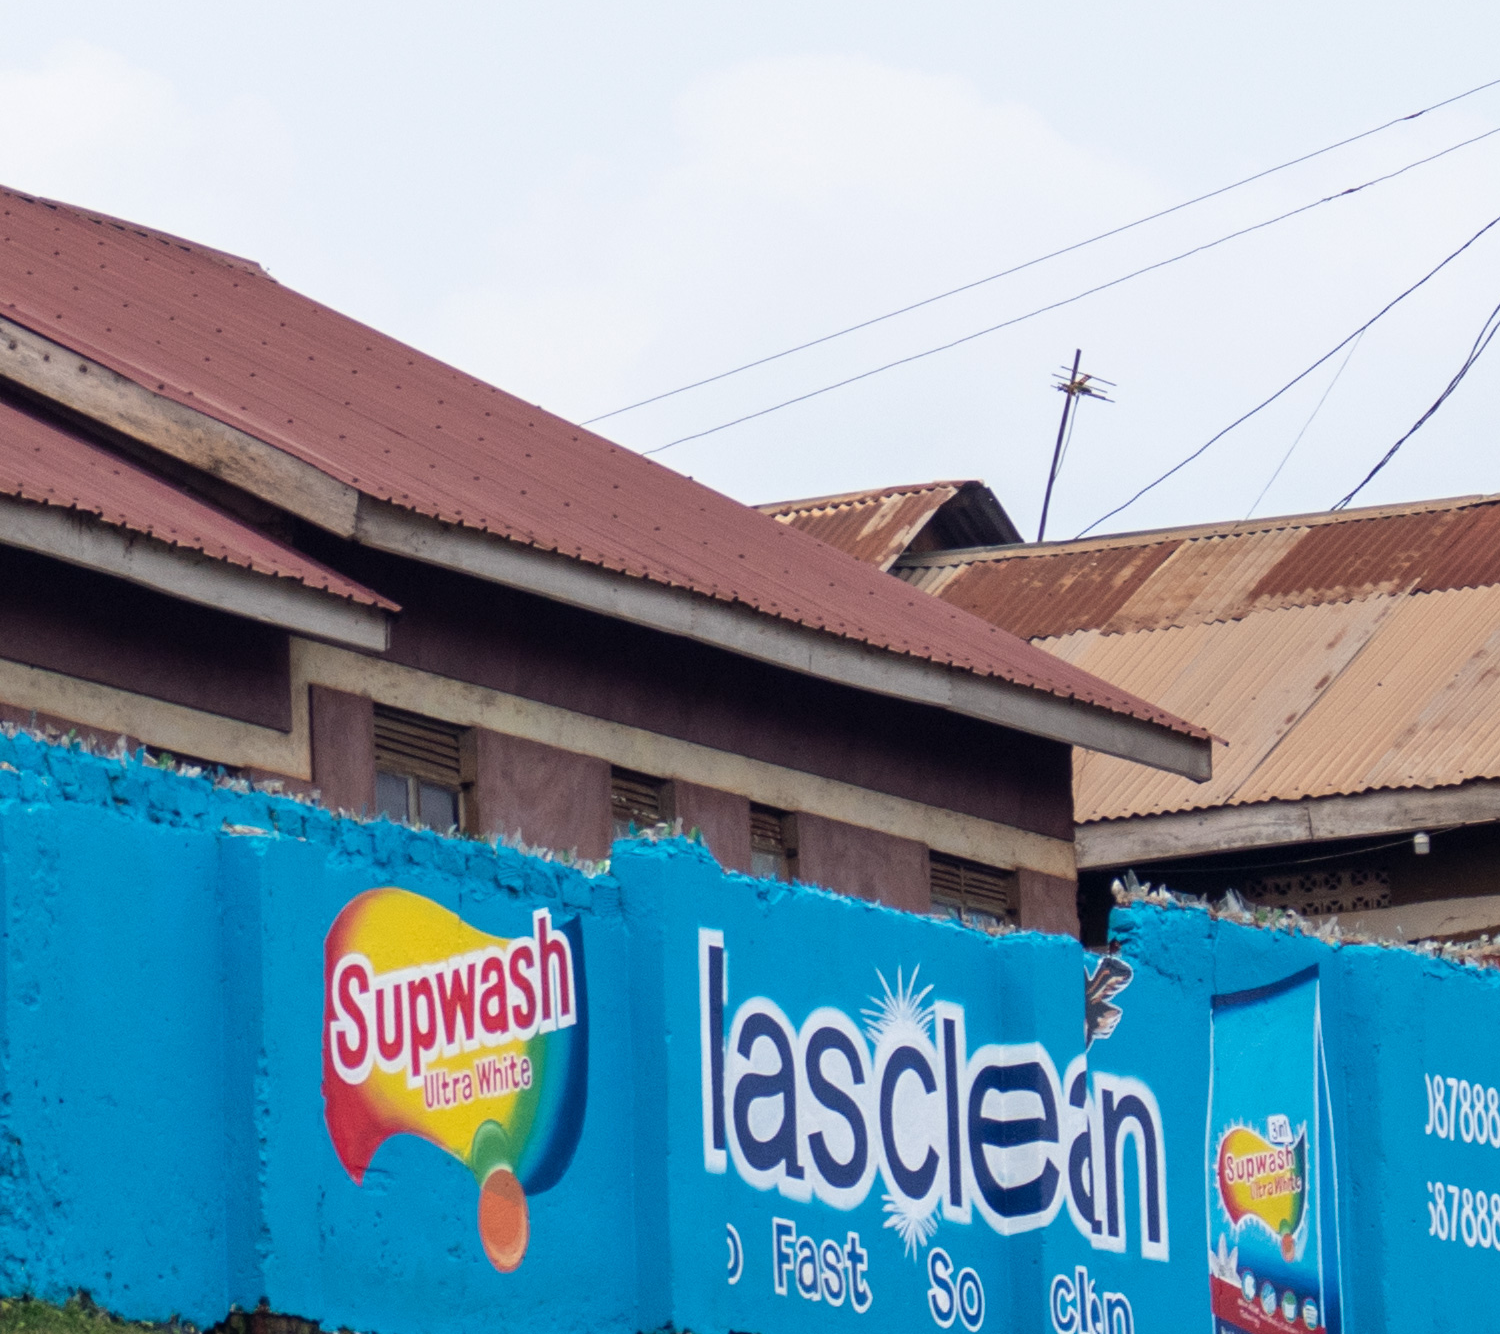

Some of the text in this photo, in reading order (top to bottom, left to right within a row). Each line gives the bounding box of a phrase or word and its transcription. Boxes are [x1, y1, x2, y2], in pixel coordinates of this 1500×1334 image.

[331, 909, 576, 1087] Supwash
[423, 1055, 532, 1110] Ultra White
[1225, 1144, 1296, 1185] Supwash
[773, 1216, 872, 1313] Fast
[928, 1247, 985, 1332] So
